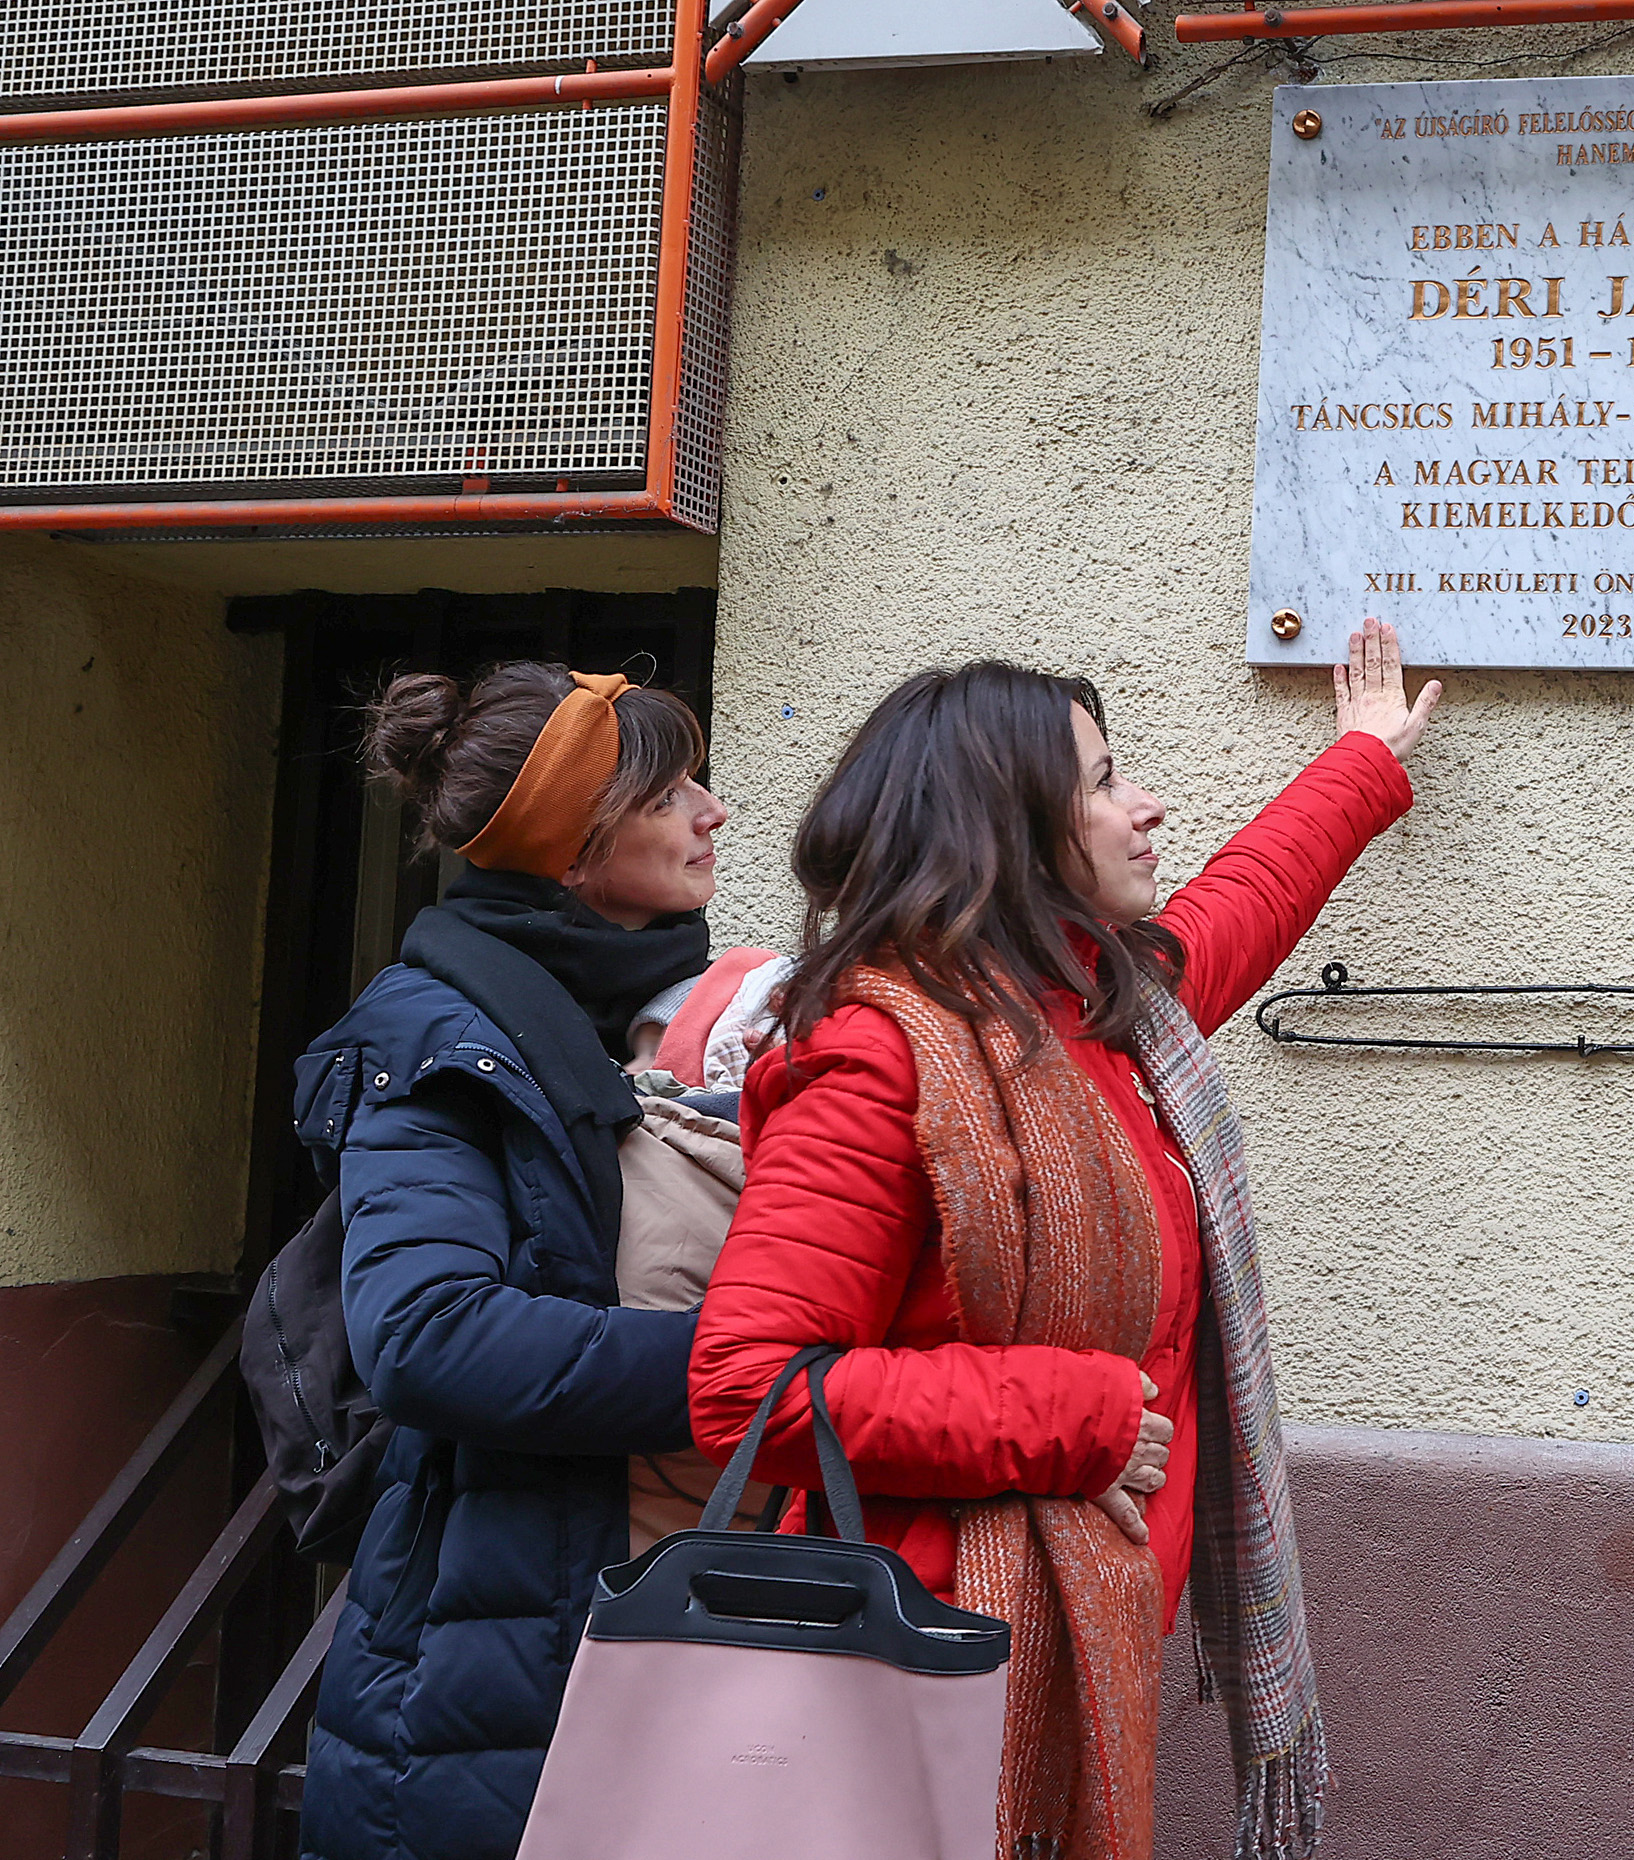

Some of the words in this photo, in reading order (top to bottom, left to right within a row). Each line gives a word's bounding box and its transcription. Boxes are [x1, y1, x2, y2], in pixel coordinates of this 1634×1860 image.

[1375, 117, 1406, 139] "AZ
[1414, 108, 1509, 138] ÚJSÁGÍRÓ
[1410, 223, 1520, 252] EBBEN
[1538, 222, 1561, 248] A
[1407, 265, 1566, 321] DÉRI
[1490, 337, 1577, 370] 1951
[1290, 396, 1454, 431] TÁNCSICS
[1373, 460, 1396, 487] A
[1413, 459, 1560, 487] MAGYAR
[1364, 573, 1423, 593] XIII.
[1438, 568, 1579, 594] KERÜLETI
[1562, 613, 1632, 639] 2023
